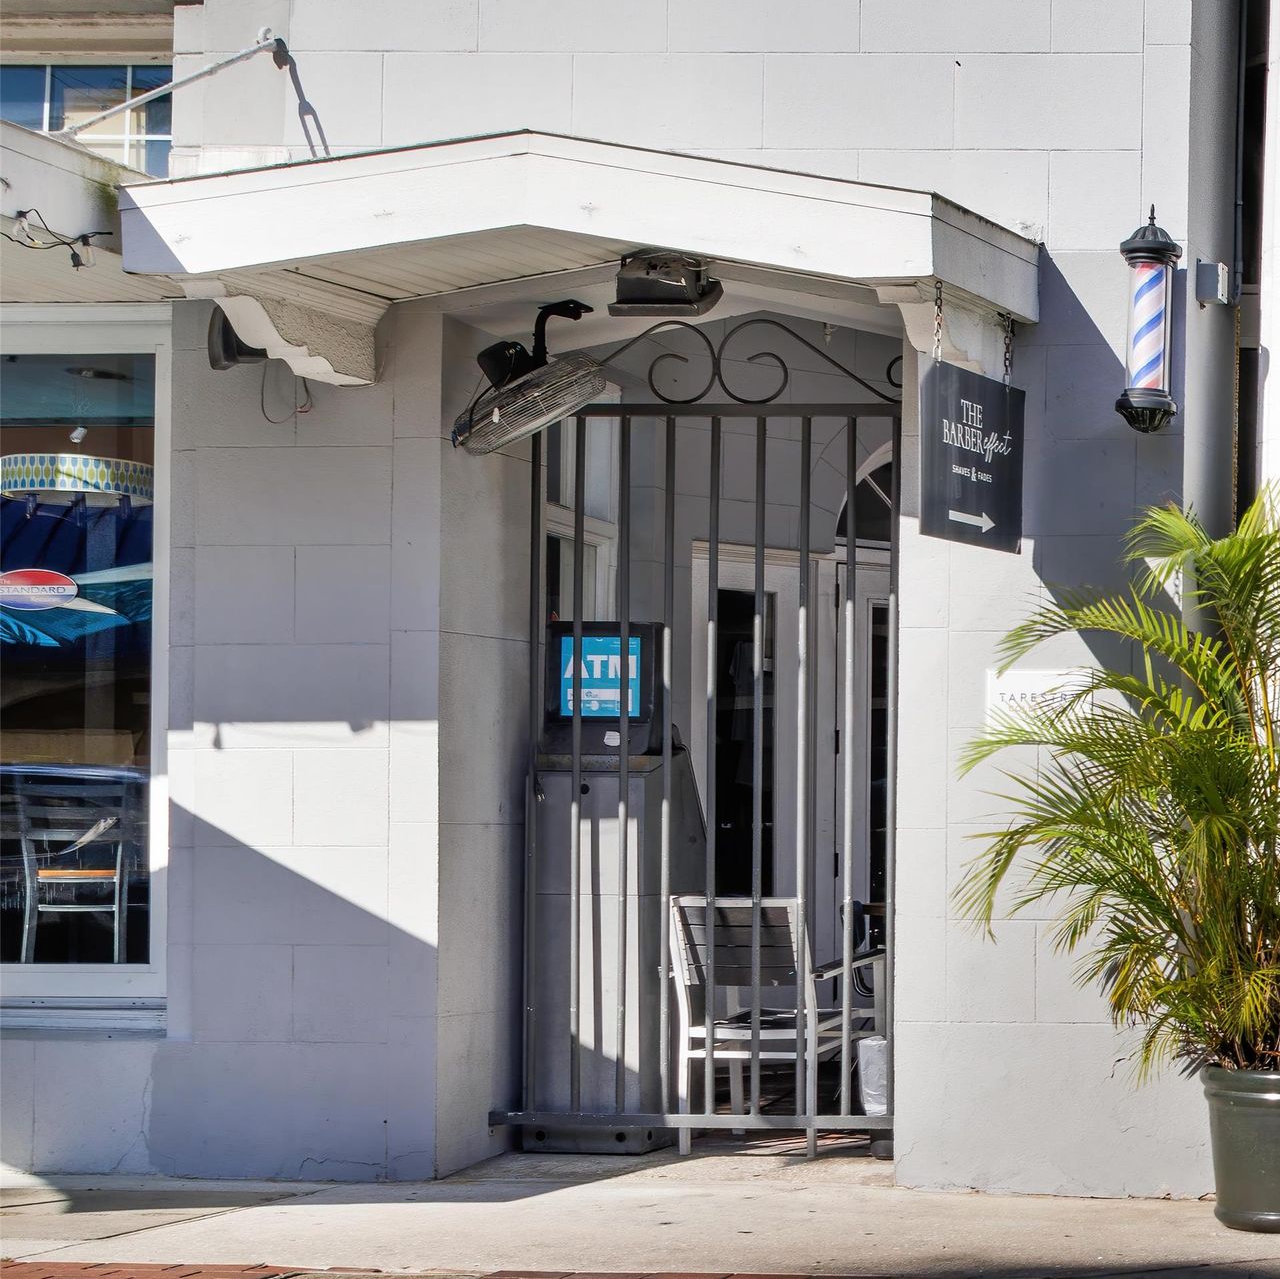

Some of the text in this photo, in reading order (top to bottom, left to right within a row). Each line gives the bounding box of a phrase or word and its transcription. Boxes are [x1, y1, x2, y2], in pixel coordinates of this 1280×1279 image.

[960, 398, 983, 429] THE
[977, 471, 992, 483] FADES
[0, 586, 66, 594] STANDARD
[563, 654, 637, 679] ATM
[999, 692, 1071, 702] TAPESTR
